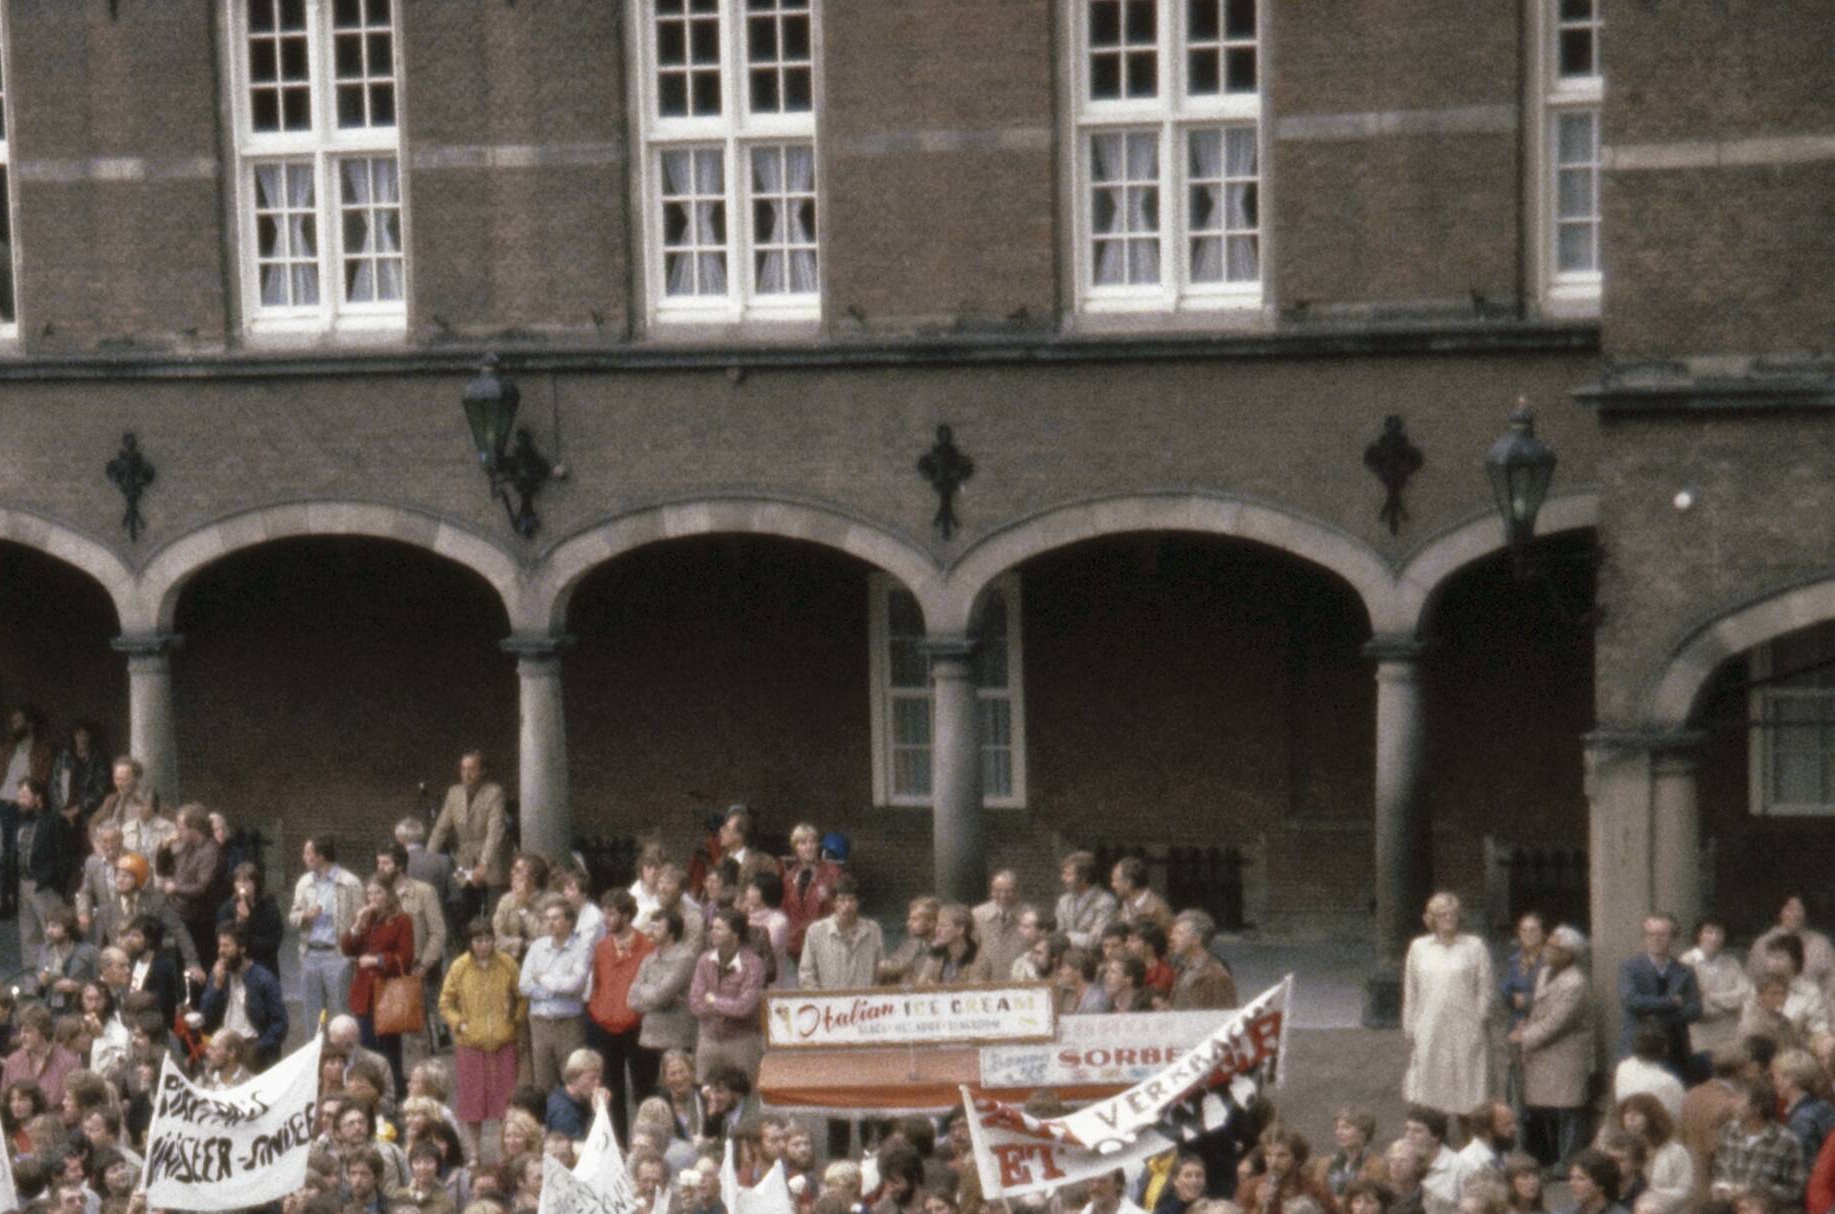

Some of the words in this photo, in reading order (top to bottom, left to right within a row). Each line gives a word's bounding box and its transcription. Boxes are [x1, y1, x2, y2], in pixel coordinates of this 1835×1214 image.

[797, 998, 894, 1038] Italian
[903, 999, 940, 1017] ICE
[950, 996, 1036, 1014] CREAM
[1058, 1048, 1184, 1068] SORBE
